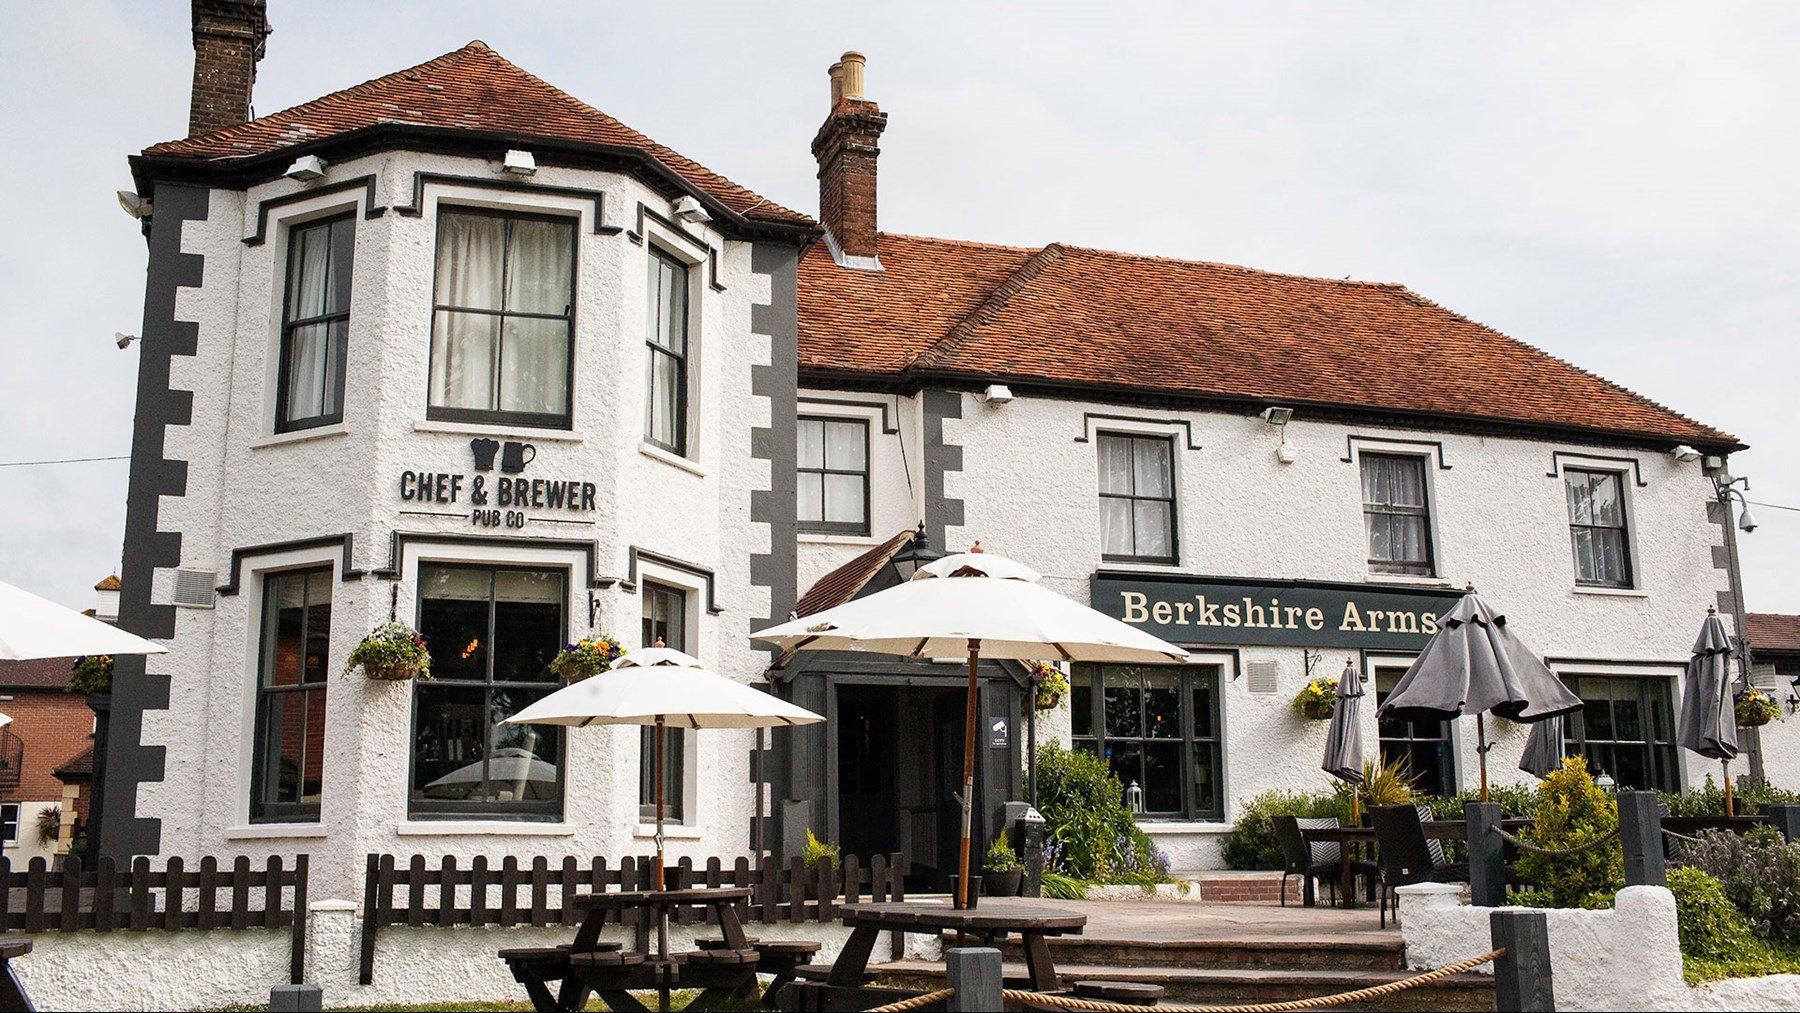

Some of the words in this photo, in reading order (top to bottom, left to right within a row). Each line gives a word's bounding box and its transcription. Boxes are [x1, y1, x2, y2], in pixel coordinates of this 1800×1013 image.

[400, 470, 463, 503] CHEF
[470, 475, 488, 506] &
[497, 476, 596, 511] BREWER
[472, 509, 500, 527] PUB
[506, 510, 524, 529] CO
[1120, 591, 1324, 630] Berkshire
[1338, 601, 1440, 635] Arms
